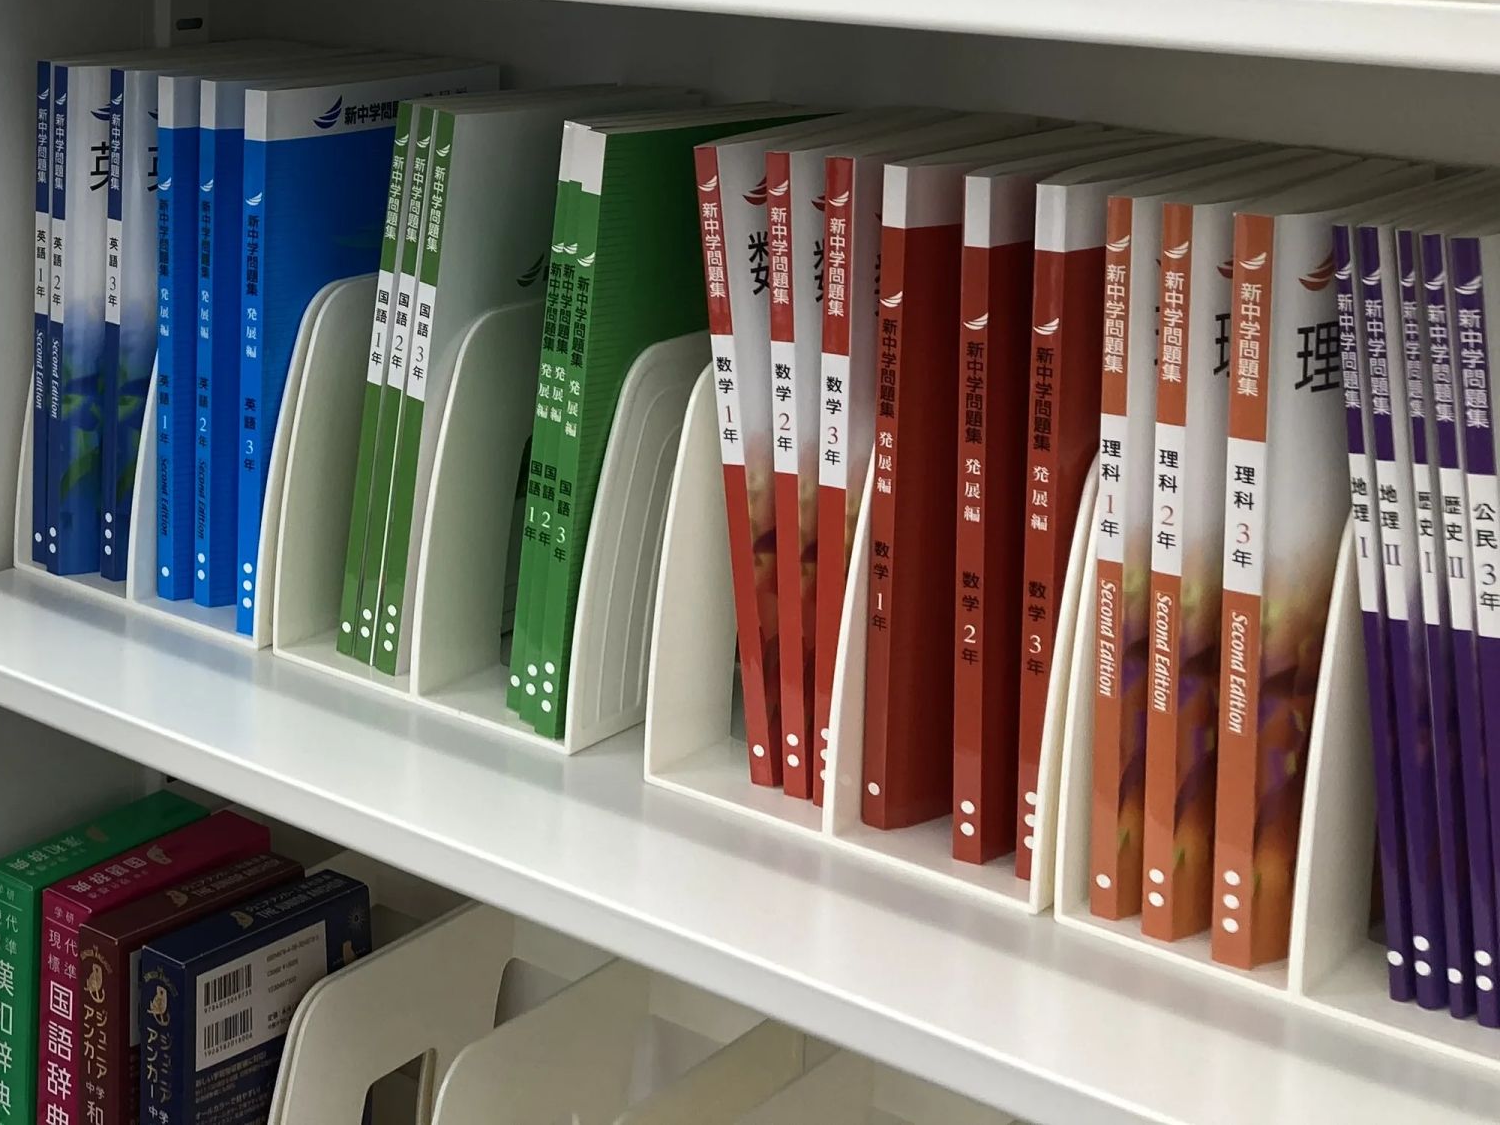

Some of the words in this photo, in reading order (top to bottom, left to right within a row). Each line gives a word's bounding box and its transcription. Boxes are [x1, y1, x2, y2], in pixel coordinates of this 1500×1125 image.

[37, 109, 47, 183] 新中学問題集
[55, 114, 64, 190] 新中学問題集
[111, 114, 121, 190] 新中学問題集
[384, 155, 404, 241] 新中学問題集
[406, 157, 426, 243] 新中学問題集
[426, 166, 446, 253] 新中学問題集
[771, 207, 789, 305] 新中学問題集
[828, 217, 846, 318] 新中学問題集
[376, 290, 389, 324] 国語
[396, 292, 409, 326] 国語
[417, 303, 430, 337] 国語
[702, 202, 726, 299] 新中学問題集
[716, 357, 734, 394] 数学
[1104, 264, 1126, 374] 新中学問題集
[1162, 271, 1184, 383] 新中学問題集
[880, 318, 898, 418] 新中学問題集
[1237, 283, 1262, 397] 新中学問題集
[51, 381, 59, 419] Edition
[775, 363, 792, 401] 数学
[826, 376, 842, 414] 数学
[877, 431, 894, 495] 発展編
[1102, 439, 1121, 482] 理科
[1158, 449, 1179, 493] 理科
[1234, 465, 1255, 510] 理科
[964, 459, 982, 523] 発展編
[1030, 466, 1049, 531] 発展編
[1474, 503, 1497, 549] 公民
[962, 572, 979, 612] 数学
[1028, 581, 1046, 622] 数学
[1100, 580, 1116, 637] Second
[1155, 593, 1172, 651] Second
[1231, 612, 1248, 672] Second
[1099, 639, 1114, 697] Edition
[1153, 654, 1170, 712] Edition
[1228, 675, 1246, 734] Edition
[55, 906, 74, 924] 学研
[46, 981, 73, 1125] 国語辞典
[84, 1004, 94, 1074] アンカー
[86, 1081, 104, 1099] 中学
